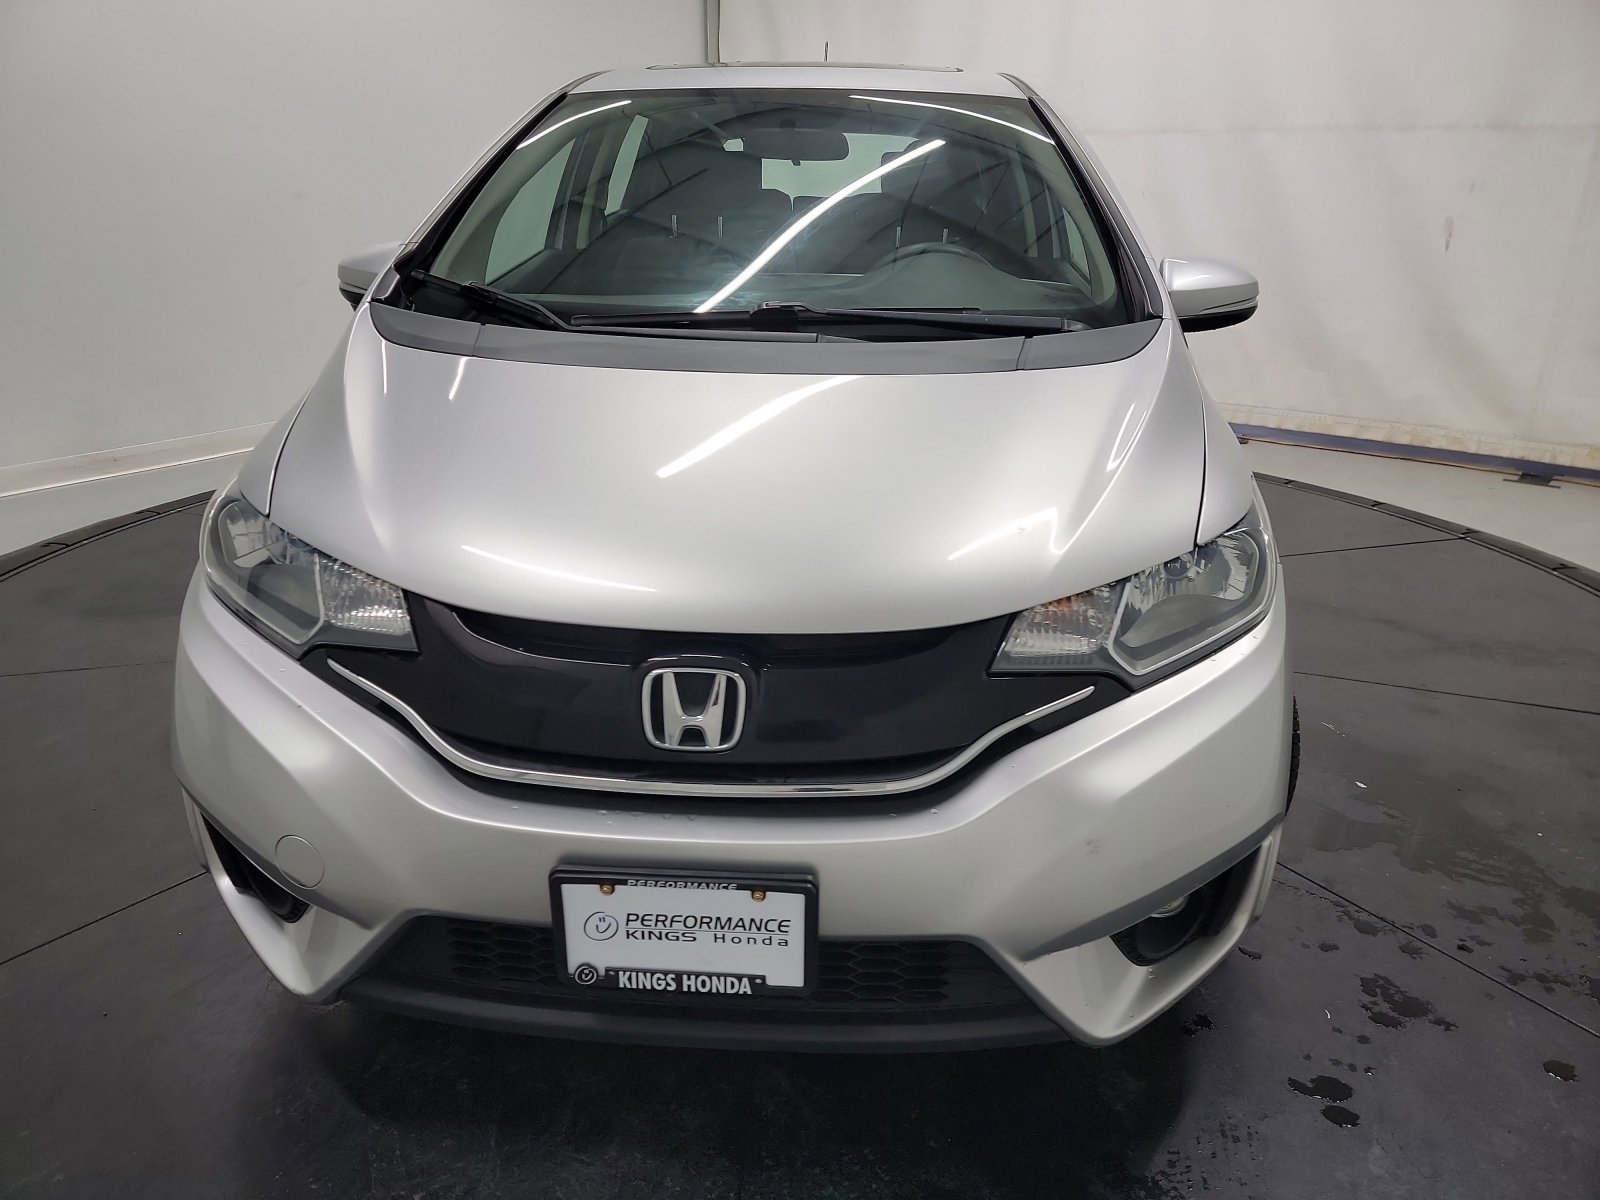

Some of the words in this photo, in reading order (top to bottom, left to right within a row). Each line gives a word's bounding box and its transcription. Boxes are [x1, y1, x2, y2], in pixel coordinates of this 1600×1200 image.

[627, 880, 738, 890] PERFORMANCE
[625, 913, 791, 933] PERFORMANCE
[625, 929, 697, 942] KINGS
[713, 933, 789, 947] Honda
[618, 971, 677, 991] KINGS
[682, 974, 752, 994] HONDA
